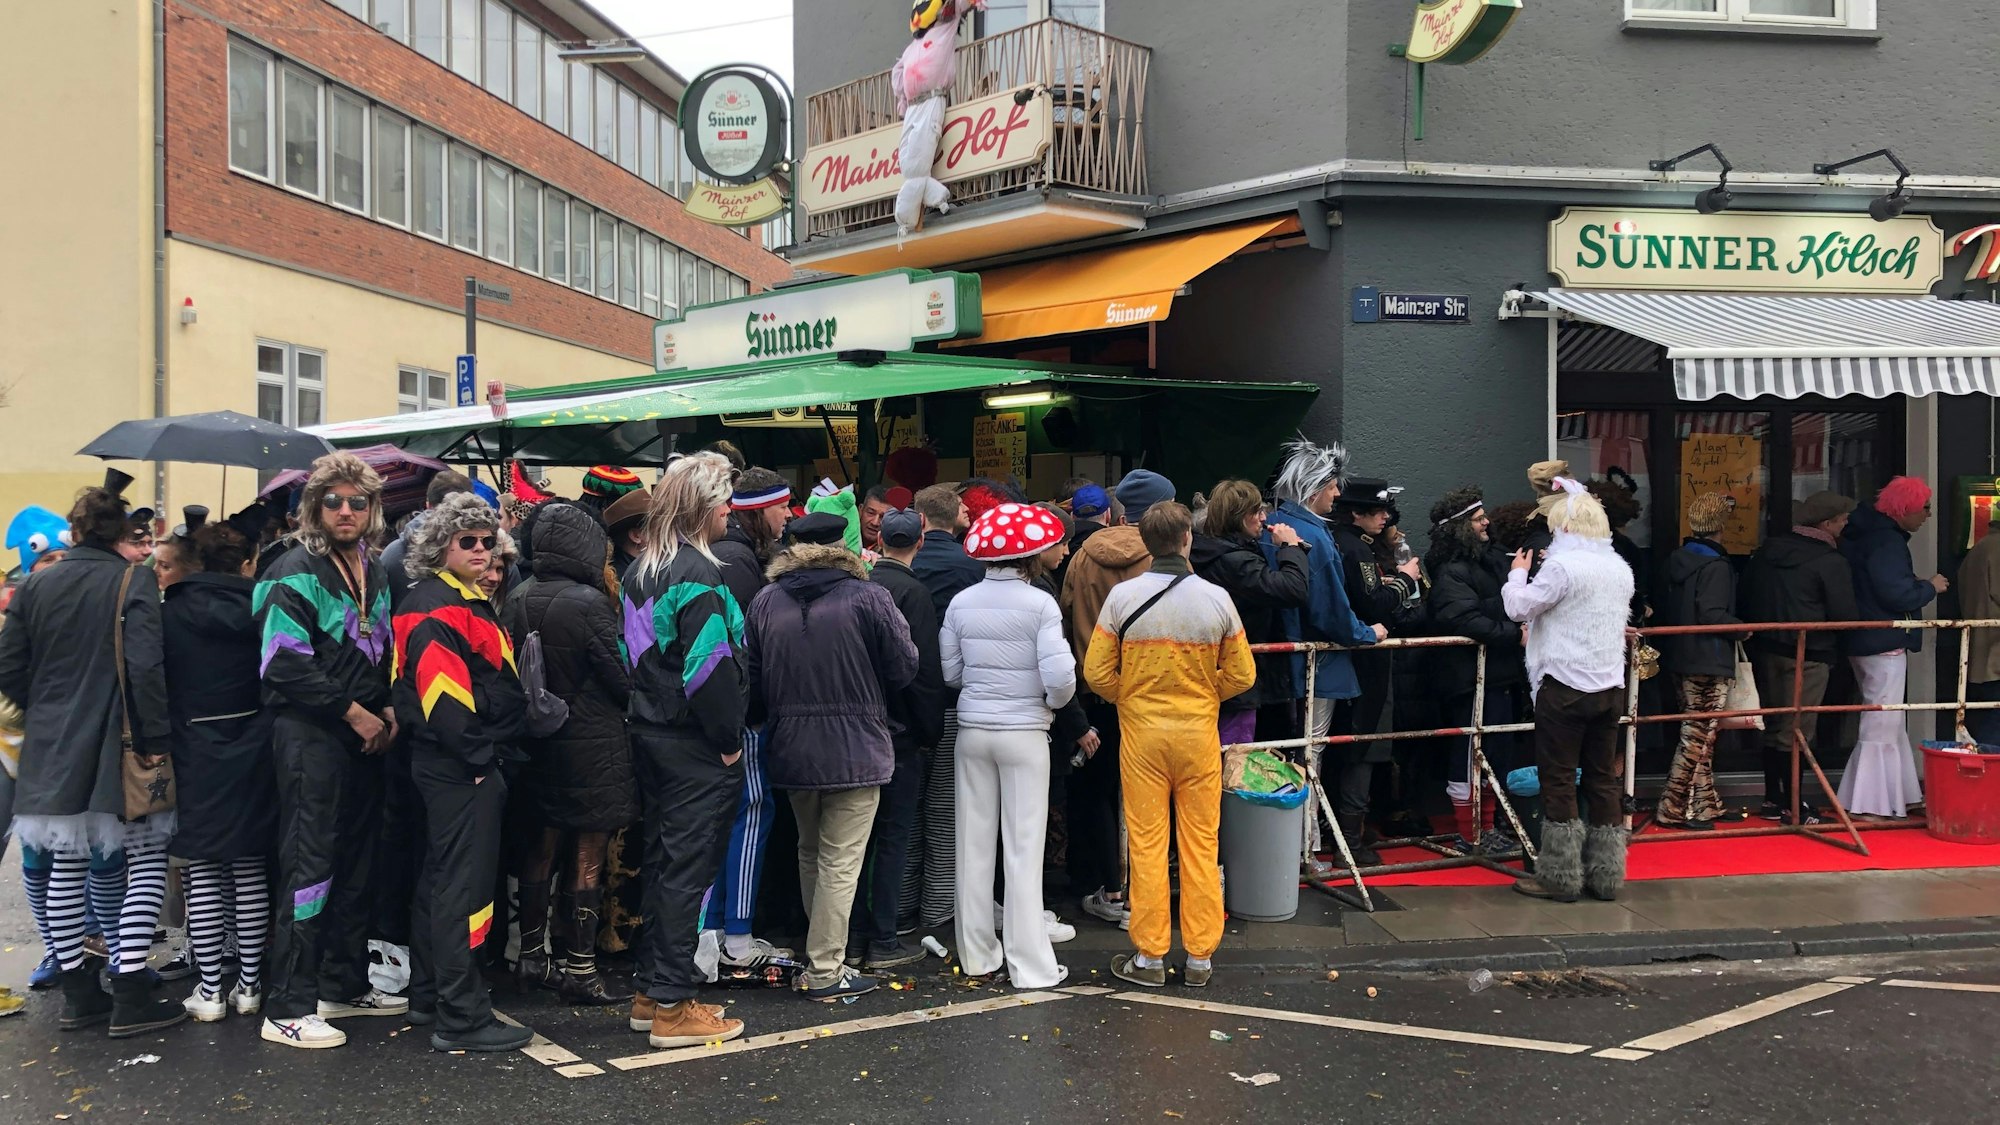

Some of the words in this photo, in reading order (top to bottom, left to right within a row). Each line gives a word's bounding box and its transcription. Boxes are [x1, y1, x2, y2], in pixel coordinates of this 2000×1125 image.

[1432, 22, 1455, 51] Hof
[708, 111, 757, 127] Sünner
[811, 147, 943, 195] Mainz
[942, 103, 1030, 169] Hof
[701, 189, 767, 205] Mainzer
[718, 205, 748, 220] Hof
[1576, 219, 1778, 271] SÜNNER
[1786, 230, 1920, 280] Kölsch
[1105, 302, 1158, 324] Sünner
[1384, 296, 1440, 315] Mainzer
[1444, 297, 1466, 316] Str.
[745, 311, 837, 359] Sünner
[975, 417, 1017, 436] GETRÄNKE
